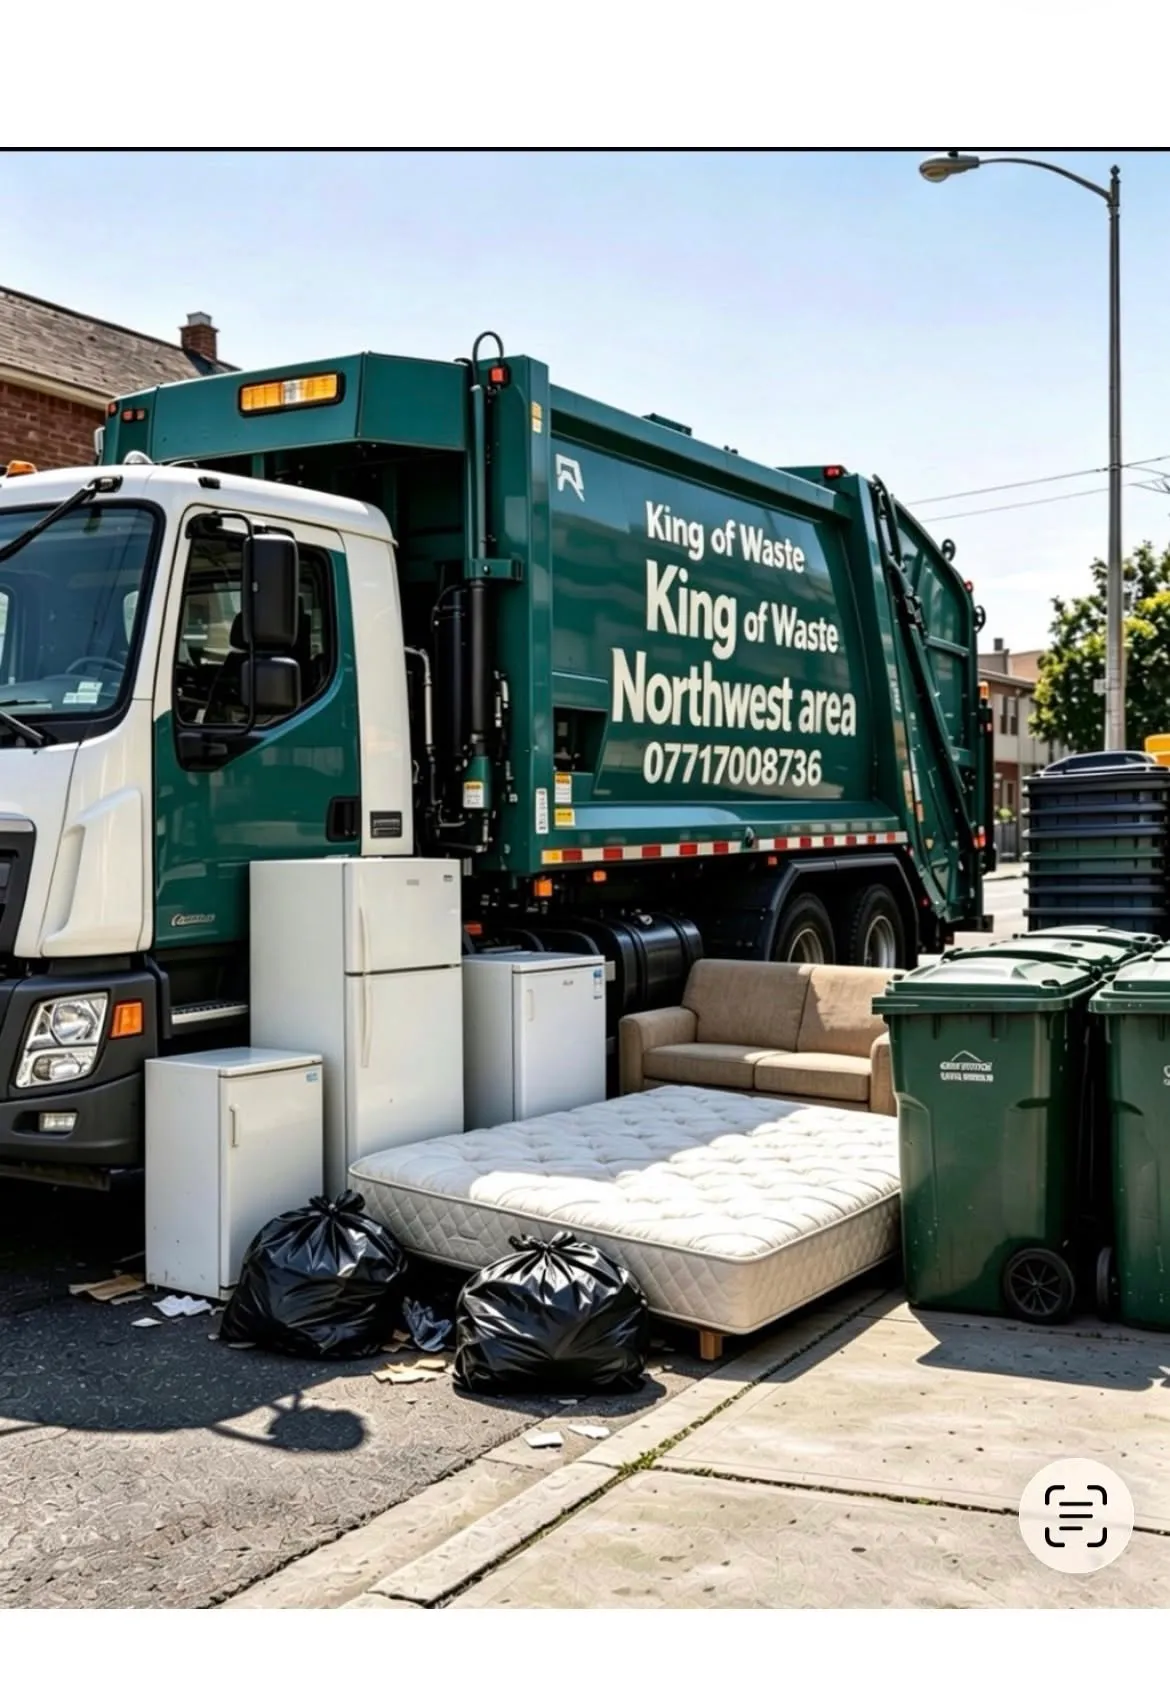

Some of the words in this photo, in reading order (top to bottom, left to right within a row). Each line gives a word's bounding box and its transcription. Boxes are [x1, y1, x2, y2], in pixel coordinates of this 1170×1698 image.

[646, 501, 704, 562] King
[711, 519, 736, 556] of
[739, 524, 805, 574] Waste
[646, 560, 736, 660] King
[744, 602, 768, 642] of
[771, 603, 839, 653] Waste
[612, 647, 793, 732] Northwest
[799, 689, 856, 736] area
[643, 742, 822, 787] 07717008736
